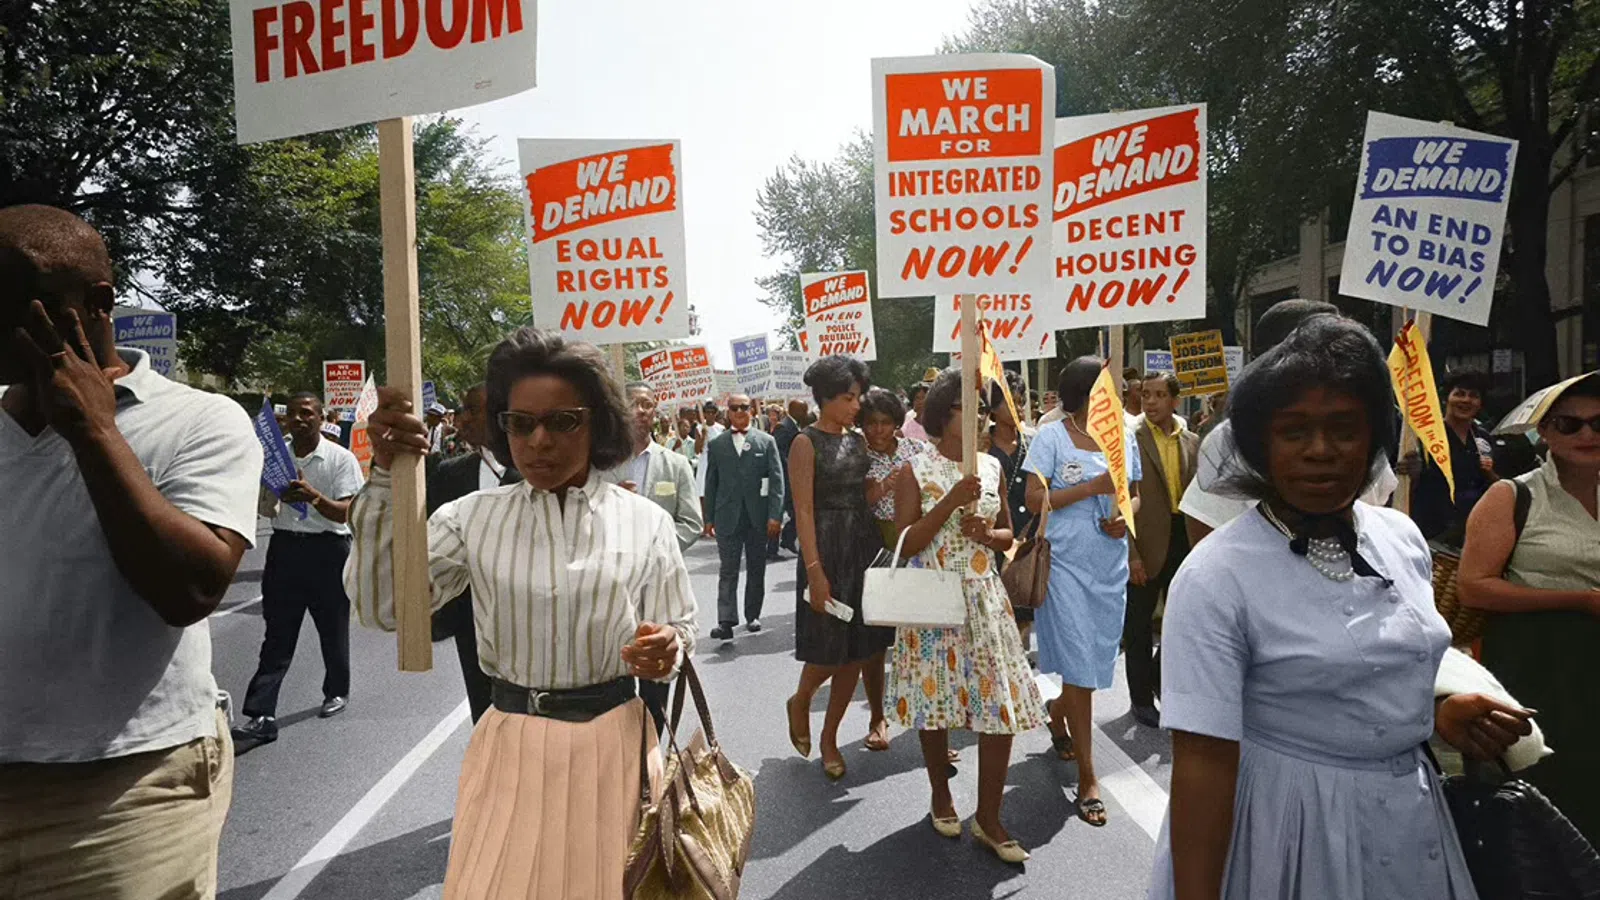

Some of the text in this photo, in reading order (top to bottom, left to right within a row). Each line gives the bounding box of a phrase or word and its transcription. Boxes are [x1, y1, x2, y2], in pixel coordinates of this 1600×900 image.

[253, 0, 523, 83] FREEDOM
[942, 78, 988, 100] WE
[899, 104, 1030, 136] MARCH
[940, 140, 990, 154] FOR
[1092, 124, 1148, 167] WE
[1412, 140, 1467, 165] WE
[576, 155, 628, 190] WE
[889, 166, 1040, 196] INTEGRATED
[1054, 144, 1194, 212] DEMAND
[1371, 166, 1502, 193] DEMAND
[542, 176, 671, 231] DEMAND
[890, 204, 1039, 234] SCHOOLS
[1068, 210, 1186, 243] DECENT
[1372, 204, 1492, 246] AN END
[556, 237, 663, 262] EQUAL
[901, 234, 1033, 280] NOW!
[1056, 244, 1197, 278] HOUSING
[1371, 230, 1485, 272] TO BIAS
[557, 266, 668, 292] RIGHTS
[824, 276, 847, 292] WE
[1065, 268, 1190, 312] NOW!
[1365, 260, 1482, 304] NOW!
[560, 291, 674, 331] NOW!
[810, 286, 864, 312] DEMAND
[953, 294, 1031, 311] RGHTS
[133, 316, 154, 327] WE
[816, 313, 834, 322] AN
[838, 312, 863, 320] END
[826, 324, 855, 332] POLICE
[951, 313, 1033, 340] W!
[119, 326, 171, 340] DEMAND
[819, 332, 862, 342] BRUTALITY
[738, 346, 765, 358] MARCH
[820, 337, 869, 356] NOW!
[1175, 345, 1205, 358] JOBS
[675, 354, 704, 365] MARCH
[754, 362, 770, 371] CLASS
[1176, 356, 1222, 372] FREEDOM
[676, 376, 712, 387] SCHOOLS
[682, 384, 712, 398] NOW!
[744, 380, 770, 394] NOW!
[330, 397, 360, 406] NOW!
[1089, 387, 1123, 474] FREEDOM
[1430, 440, 1448, 464] '63
